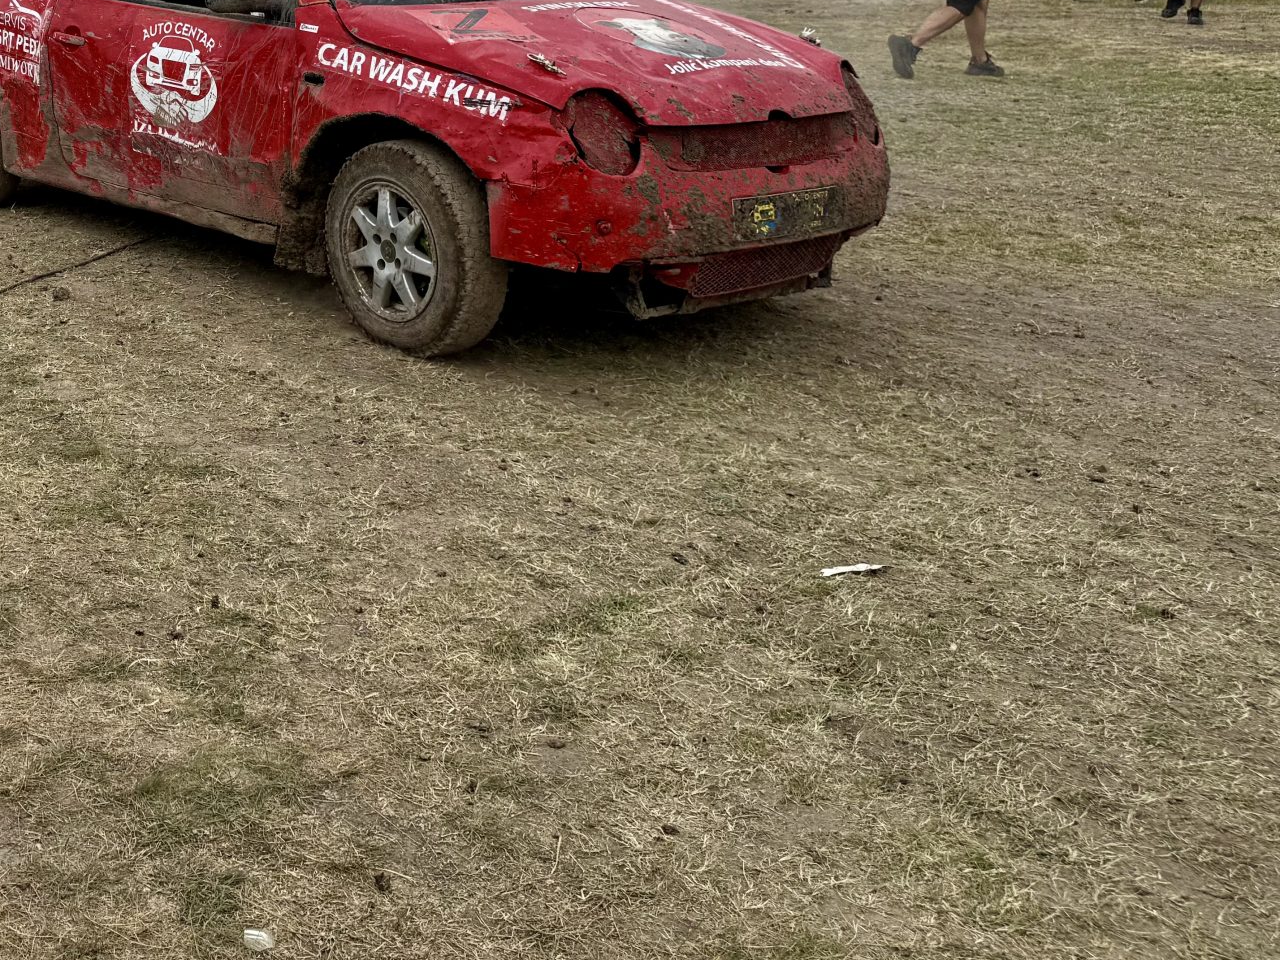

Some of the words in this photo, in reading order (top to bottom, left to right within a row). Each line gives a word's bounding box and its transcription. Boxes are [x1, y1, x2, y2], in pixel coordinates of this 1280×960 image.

[142, 21, 173, 41] AUTO
[174, 21, 216, 53] CENTAR
[317, 43, 366, 76] CAR
[369, 56, 442, 98] WASH
[442, 78, 512, 122] KUM
[664, 58, 703, 75] Jolić
